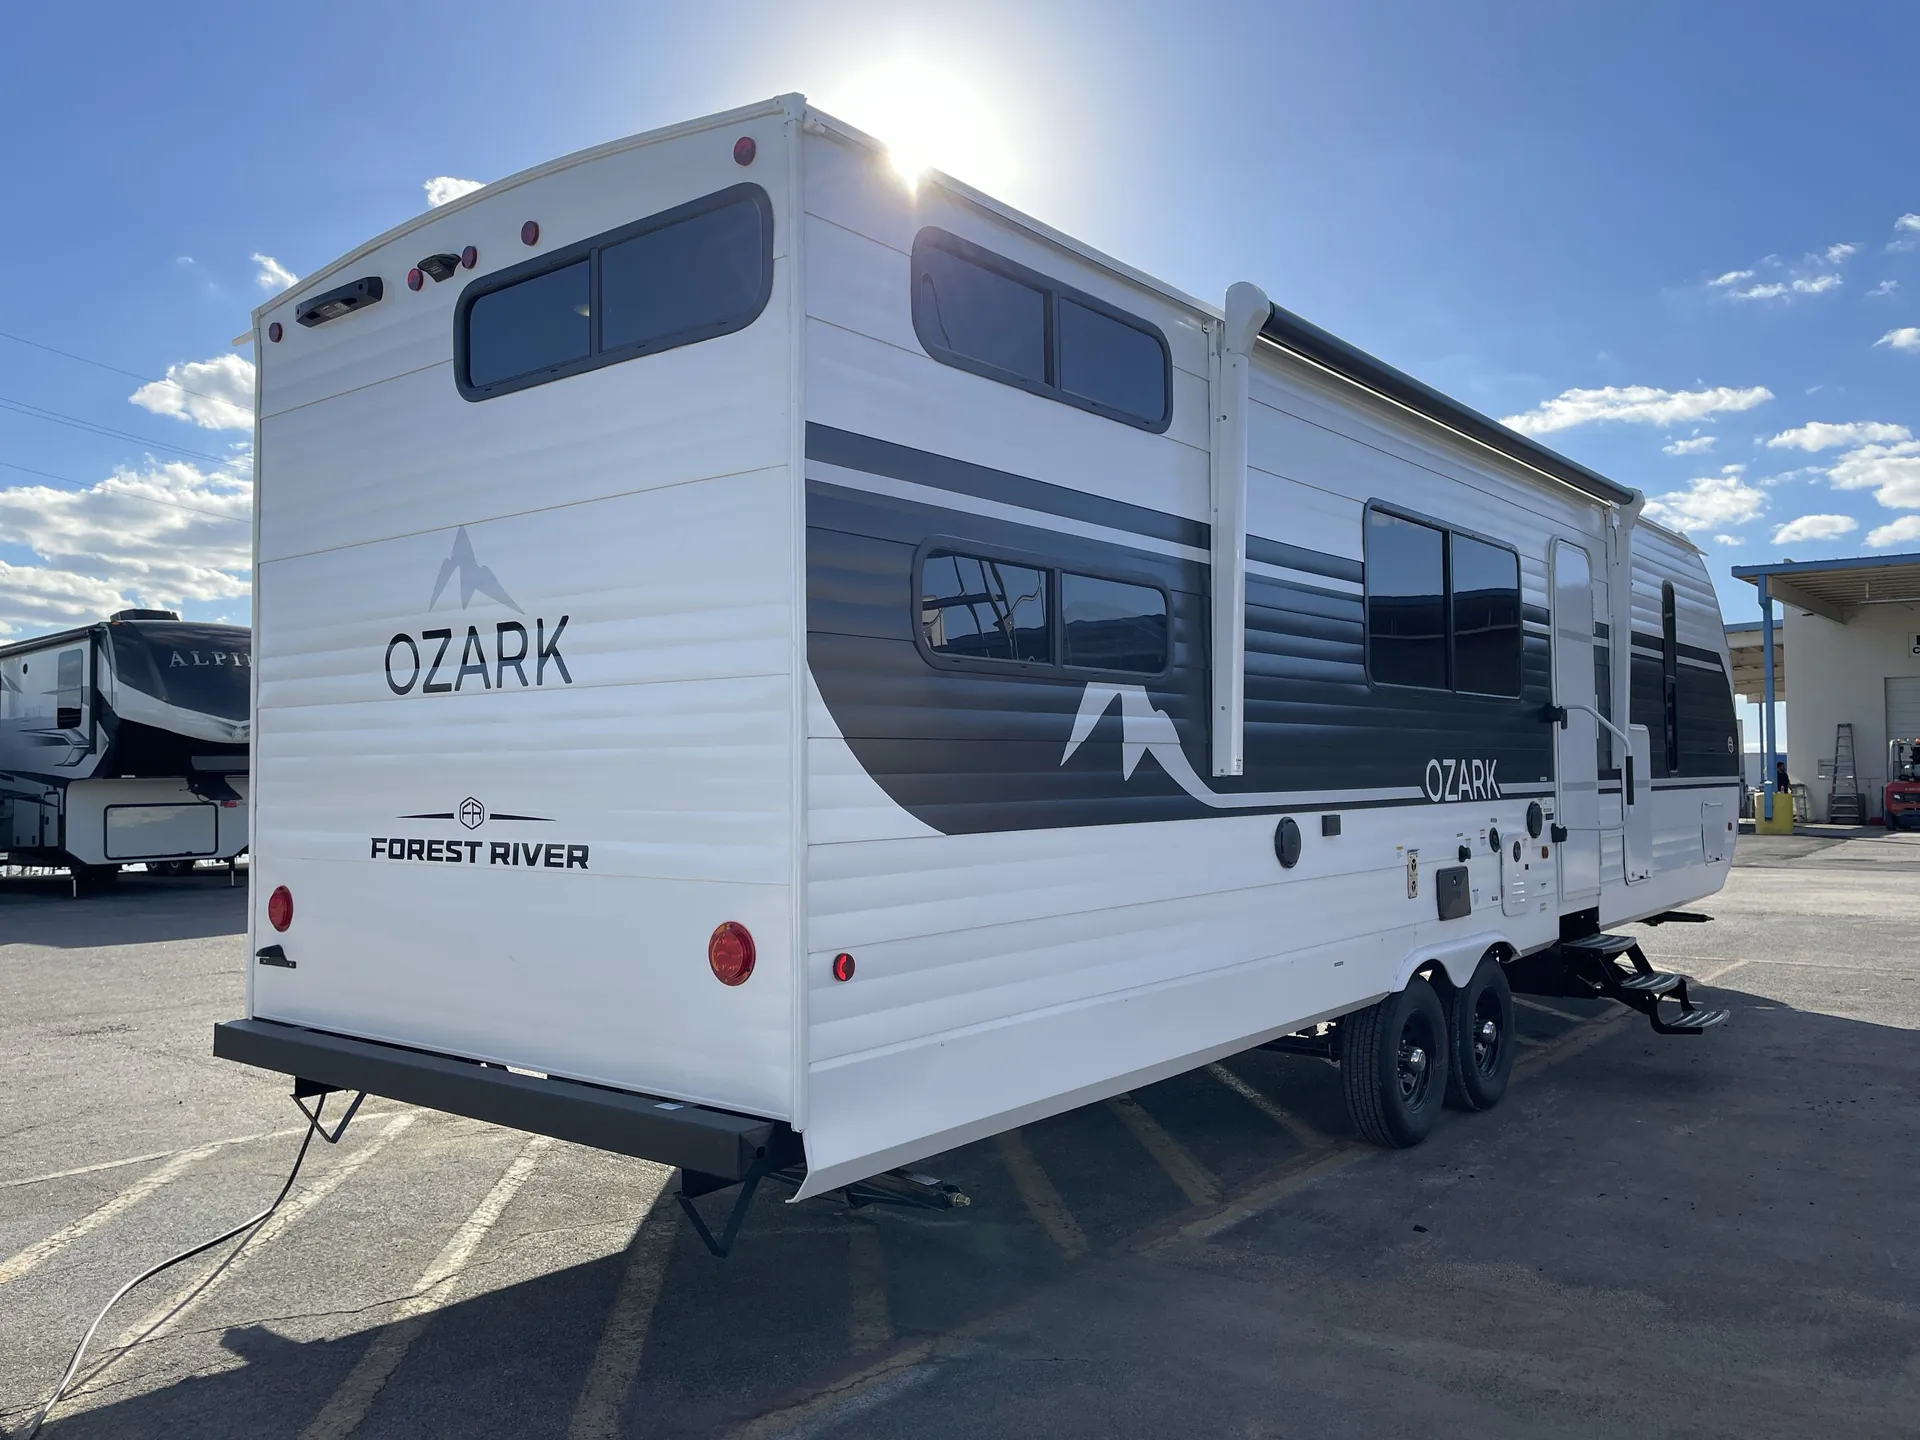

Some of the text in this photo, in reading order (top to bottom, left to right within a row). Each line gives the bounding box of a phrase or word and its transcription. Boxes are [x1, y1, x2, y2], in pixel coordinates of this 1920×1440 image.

[385, 615, 572, 695] OZARK
[1425, 758, 1501, 803] OZARK
[370, 837, 590, 870] FOREST RIVER
